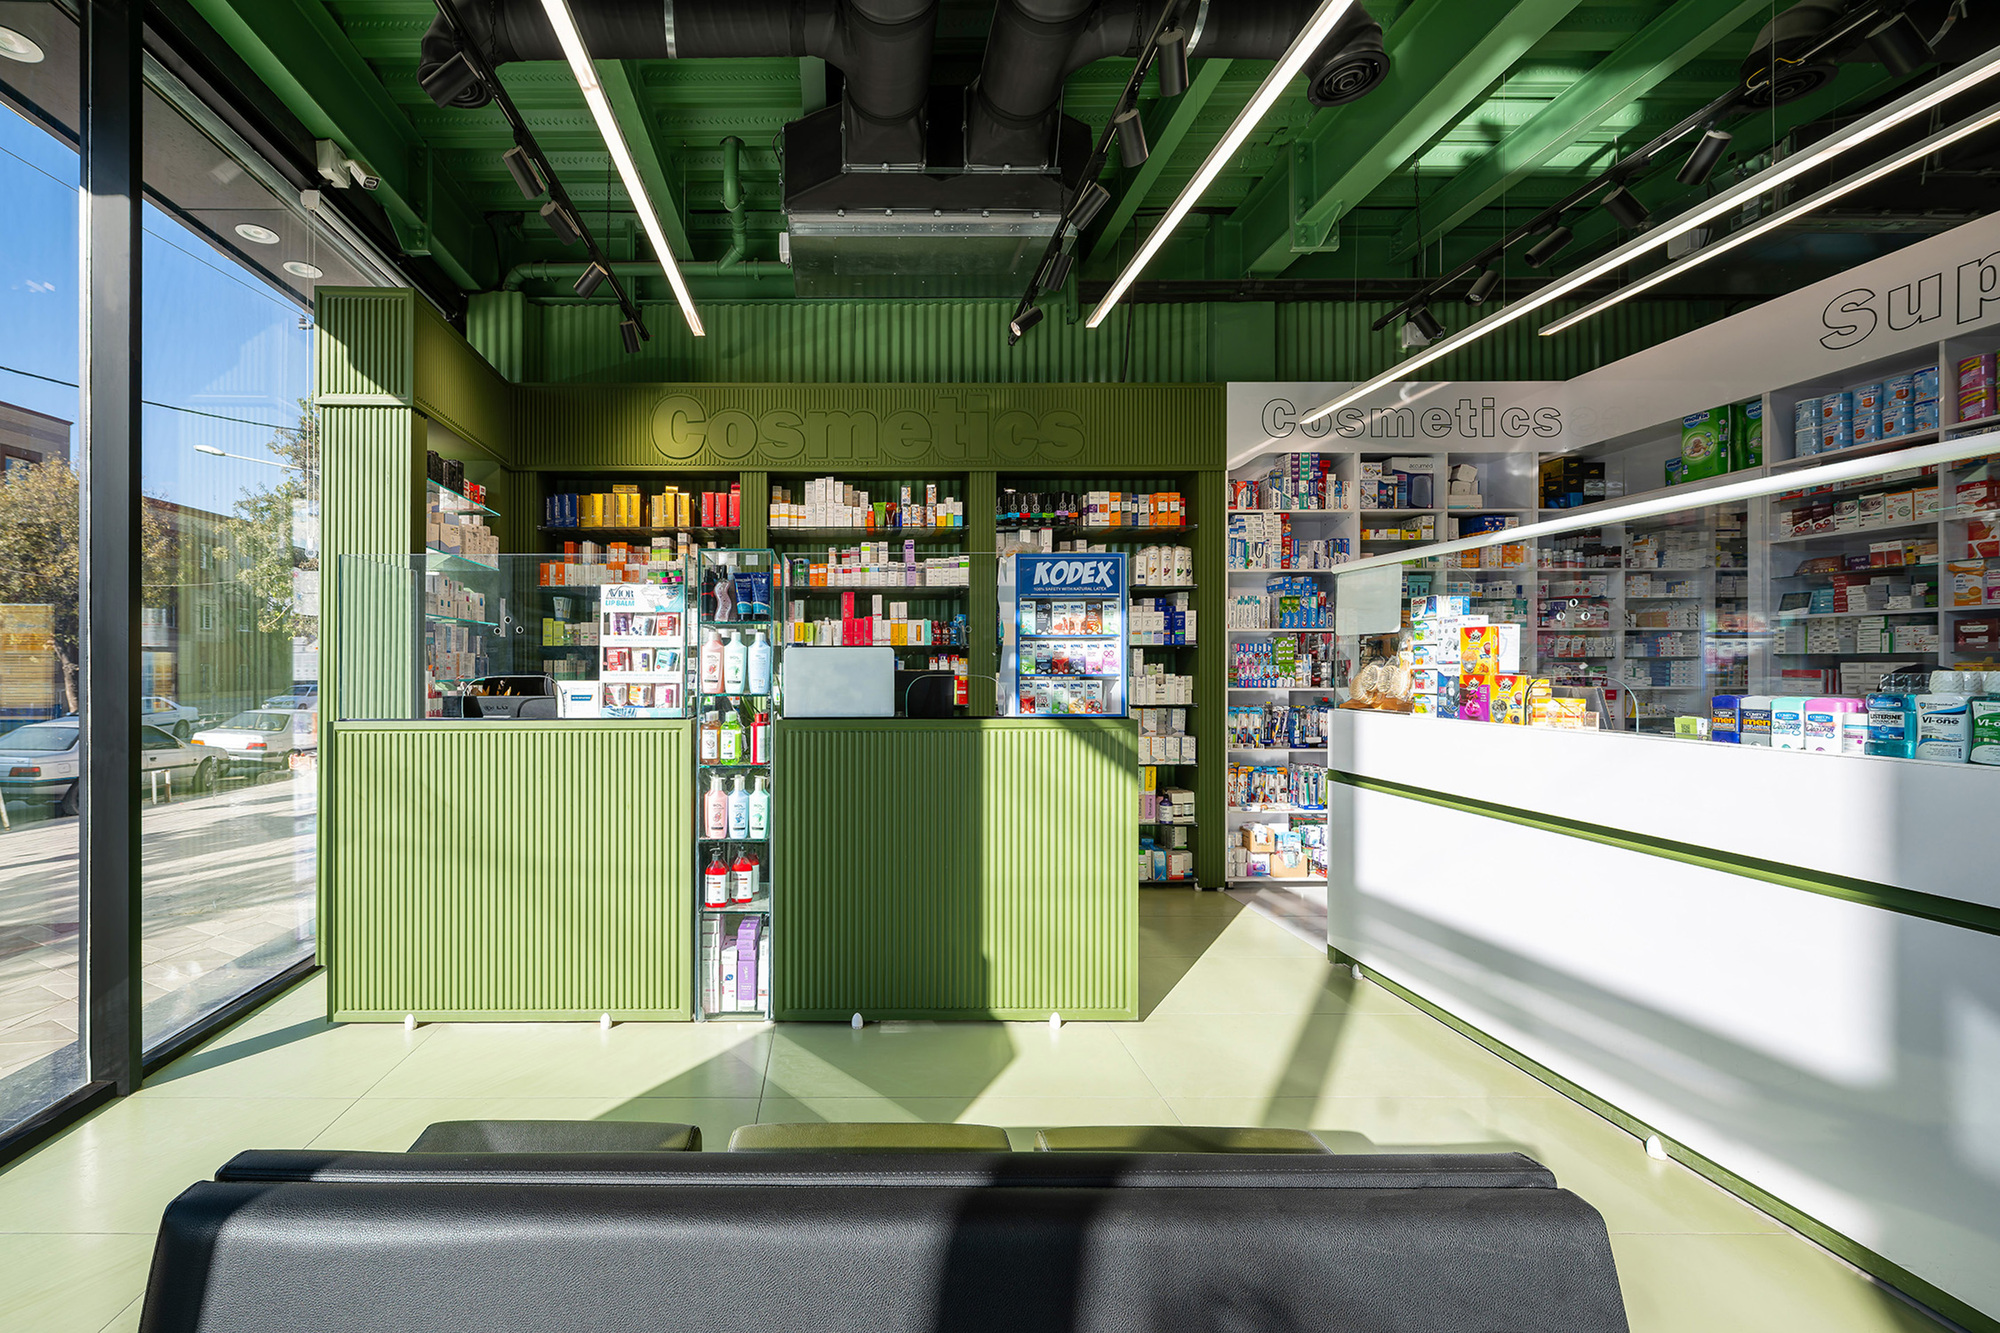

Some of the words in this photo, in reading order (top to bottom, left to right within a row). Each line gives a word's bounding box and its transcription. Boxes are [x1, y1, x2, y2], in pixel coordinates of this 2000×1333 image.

[650, 392, 1087, 462] Cosmetics
[1261, 396, 1563, 439] Cosmetics
[1033, 560, 1113, 588] KODEX
